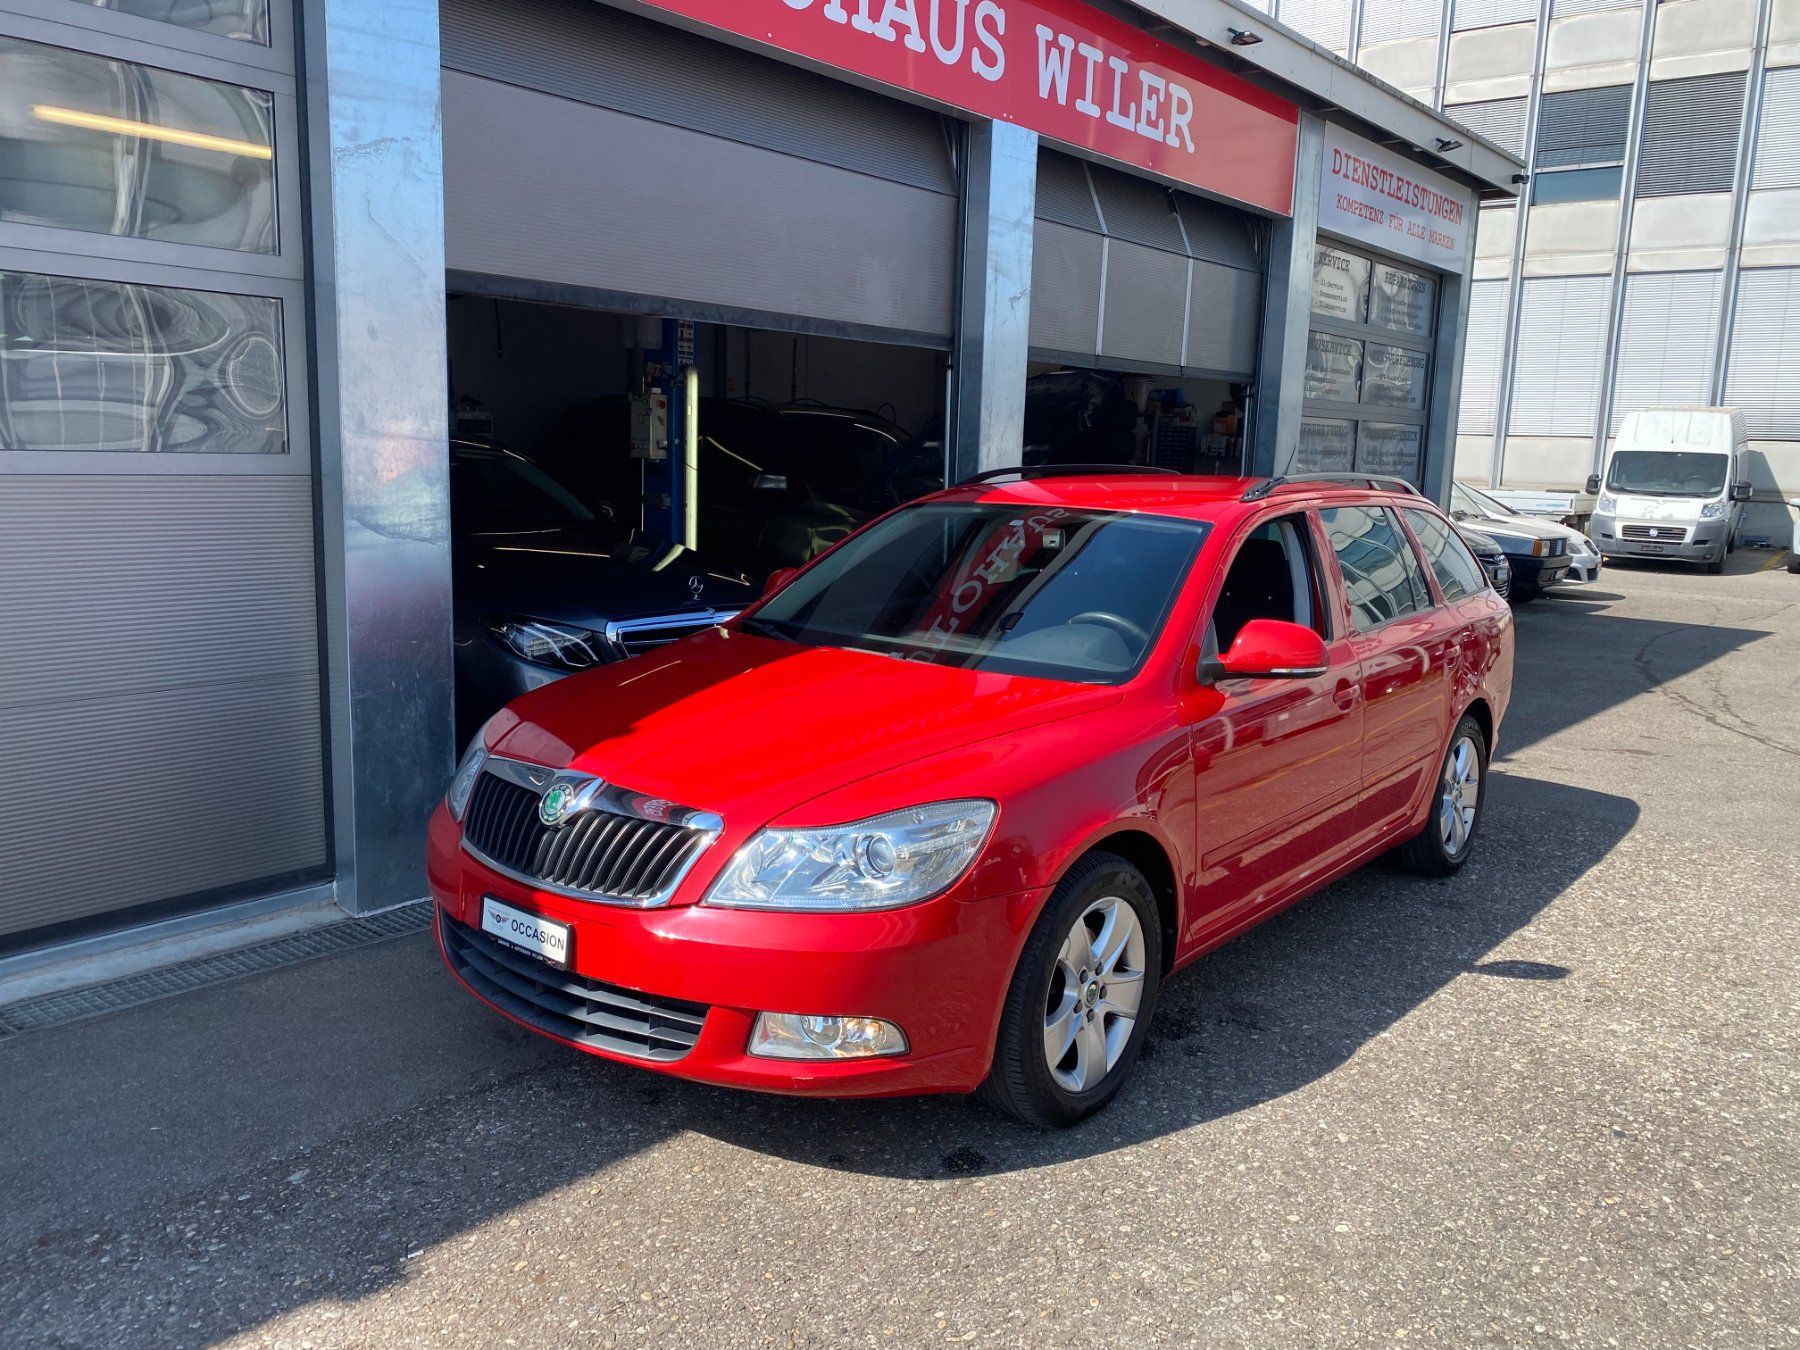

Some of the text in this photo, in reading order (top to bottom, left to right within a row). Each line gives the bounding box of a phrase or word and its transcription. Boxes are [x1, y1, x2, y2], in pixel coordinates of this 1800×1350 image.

[782, 0, 1195, 154] AUS WILER
[1332, 148, 1464, 226] DIENSTLEISTUNGEN
[1336, 193, 1456, 250] KOMPETENZ FÜR ALLE MARKEN
[1318, 252, 1351, 272] SERVICE
[511, 919, 565, 951] OCCASION
